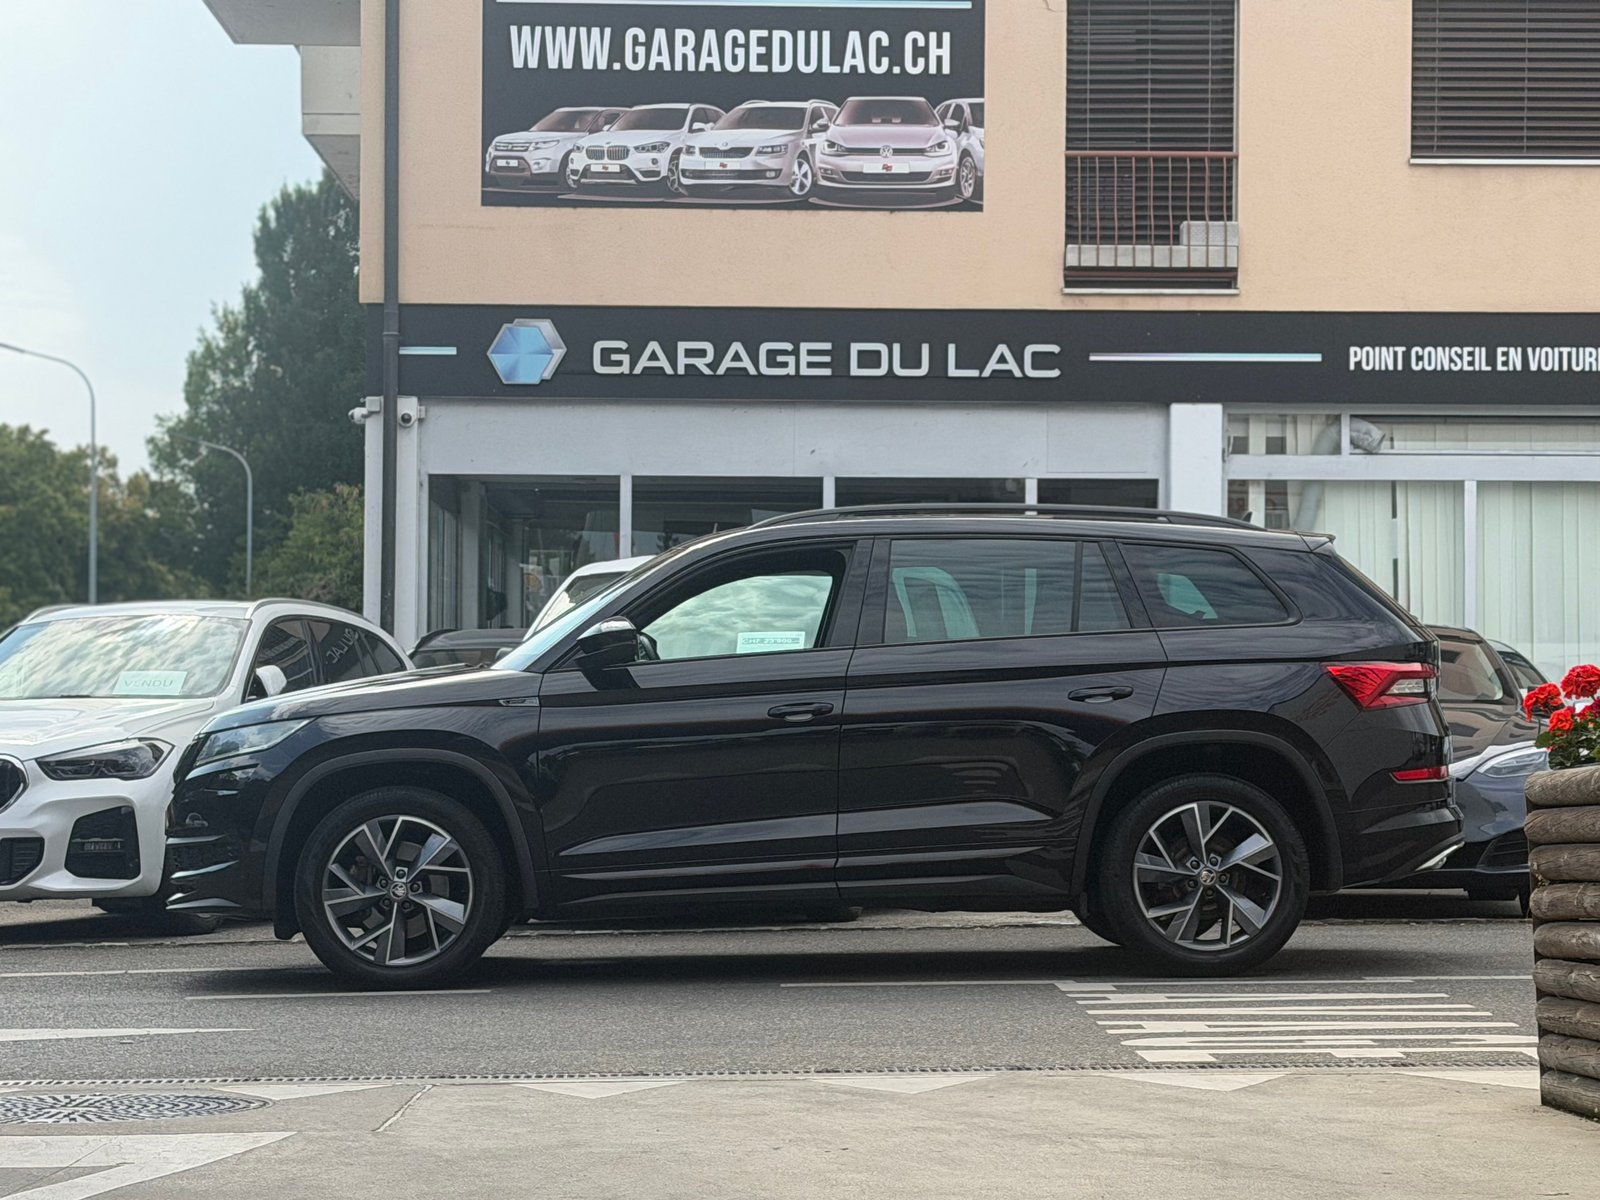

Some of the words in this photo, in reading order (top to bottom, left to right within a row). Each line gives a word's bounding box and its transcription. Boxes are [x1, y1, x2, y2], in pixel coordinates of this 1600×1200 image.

[509, 25, 951, 75] WWW.GARAGEDULAC.CH
[592, 340, 833, 377] GARAGE
[849, 342, 930, 377] DU
[947, 343, 1062, 378] LAC
[1349, 346, 1407, 371] POINT
[1410, 346, 1492, 371] CONSEIL
[1496, 347, 1523, 371] EN
[1526, 347, 1600, 372] VOITUR
[124, 679, 173, 688] VENDU
